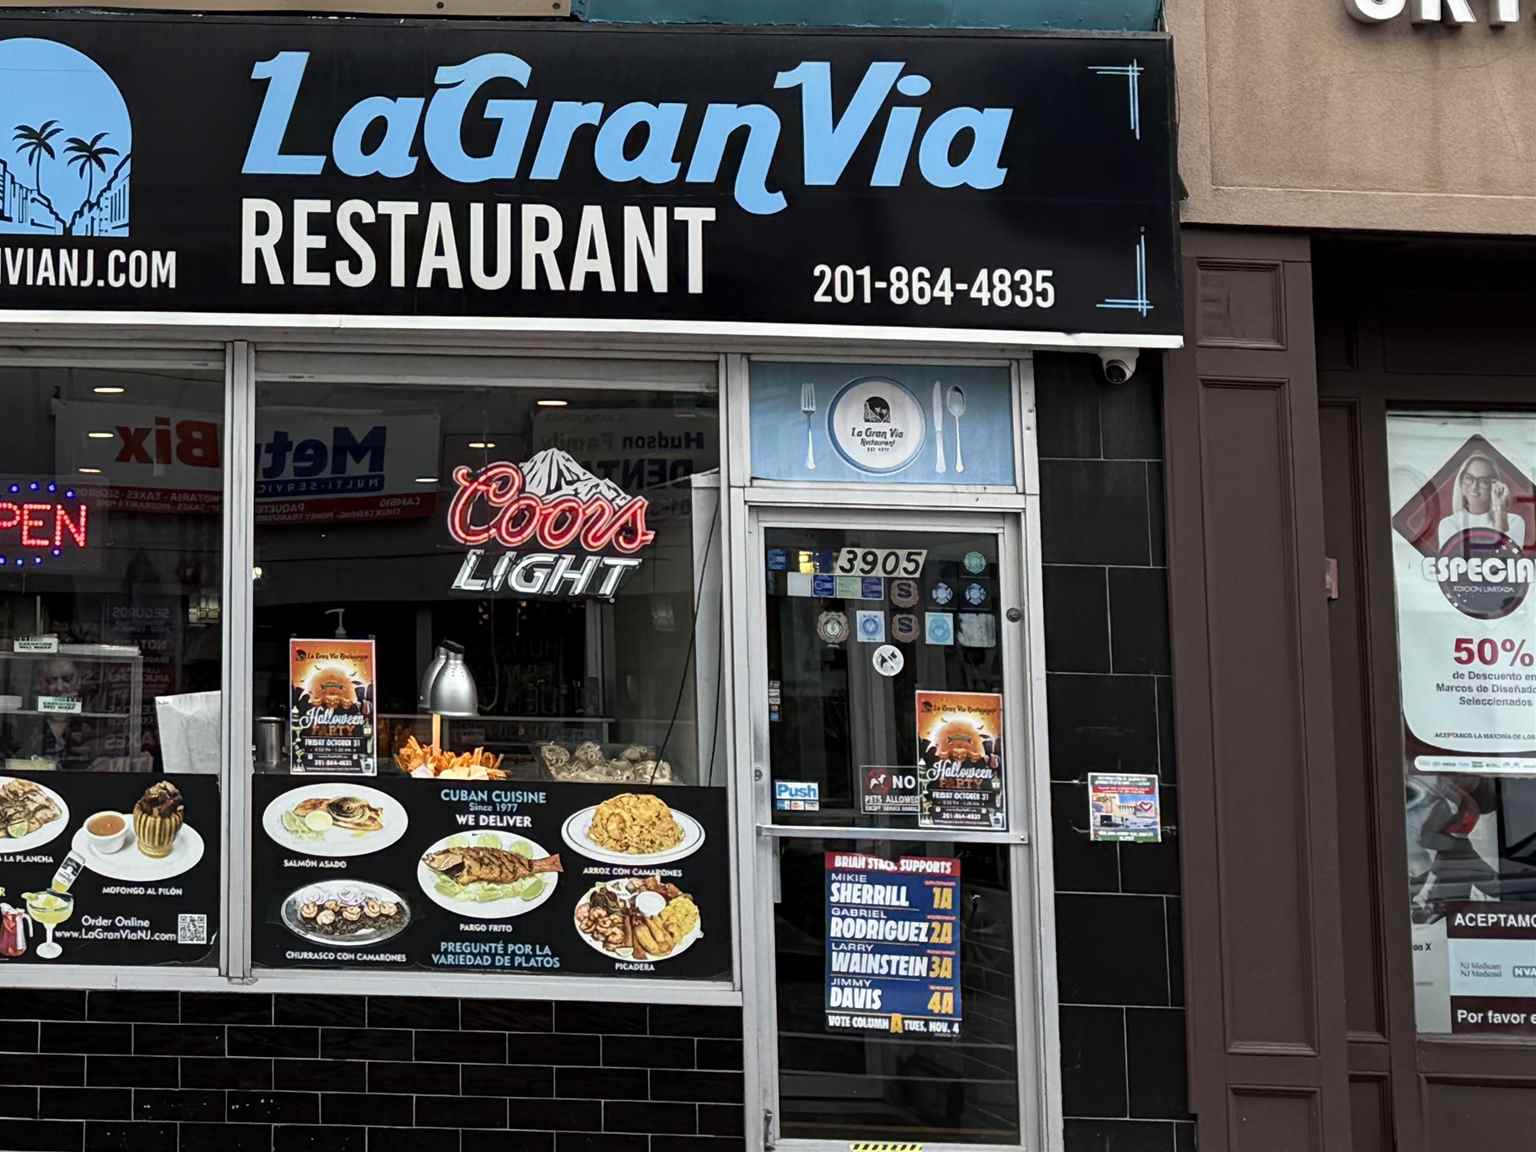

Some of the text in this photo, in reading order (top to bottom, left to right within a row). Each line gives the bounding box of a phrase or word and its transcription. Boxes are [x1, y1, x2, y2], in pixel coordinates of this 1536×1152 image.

[241, 198, 716, 295] RESTAURANT
[813, 263, 1055, 309] 201-864-4835
[447, 460, 656, 554] Coors
[839, 549, 923, 575] 3905
[451, 548, 643, 598] LIGHT
[1422, 556, 1536, 584] ESPECIA
[1454, 637, 1535, 667] 50%
[1452, 671, 1465, 680] de
[1468, 671, 1522, 681] Descuento
[1436, 683, 1474, 693] Marcos
[1476, 683, 1488, 693] de
[1459, 696, 1533, 706] Seleccionados
[299, 706, 364, 728] Halloween
[927, 759, 992, 780] Halloween
[892, 775, 916, 789] NO
[441, 789, 547, 804] CUBAN CUISINE
[777, 783, 817, 799] Push
[865, 795, 882, 804] PETS
[469, 802, 518, 812] Since 1977
[456, 814, 533, 827] WE DELIVER
[4, 855, 15, 863] LA
[16, 855, 54, 864] PLANCHA
[283, 858, 347, 868] SALMÓN ASADO
[834, 855, 865, 870] BRIAN
[900, 859, 952, 874] SUPPORTS
[583, 867, 610, 875] ARROZ
[612, 868, 630, 876] CON
[831, 873, 867, 883] MIKIE
[147, 887, 157, 895] AL
[830, 882, 953, 910] SHERRILL 1A
[831, 907, 887, 919] GABRIEL
[81, 915, 150, 928] Order Online
[460, 924, 513, 933] PARGO FRITO
[55, 928, 177, 942] www.LaGranViaNJ.com
[830, 917, 953, 945] RODRIGUEZ 2A
[440, 940, 552, 955] PREGUNTÉ POR LA
[831, 943, 874, 952] LARRY
[286, 950, 407, 962] CHURRASCO CON CAMARONES
[432, 954, 560, 968] VARIEDAD DE PLATOS
[615, 963, 655, 971] PICADERA
[831, 952, 953, 979] WAINSTEIN 3A
[831, 978, 872, 987] JIMMY
[830, 987, 954, 1014] DAVIS 4A
[828, 1013, 959, 1034] VOTE COLUMN A TUES. NOV. 4
[1457, 1009, 1527, 1024] Por favor
